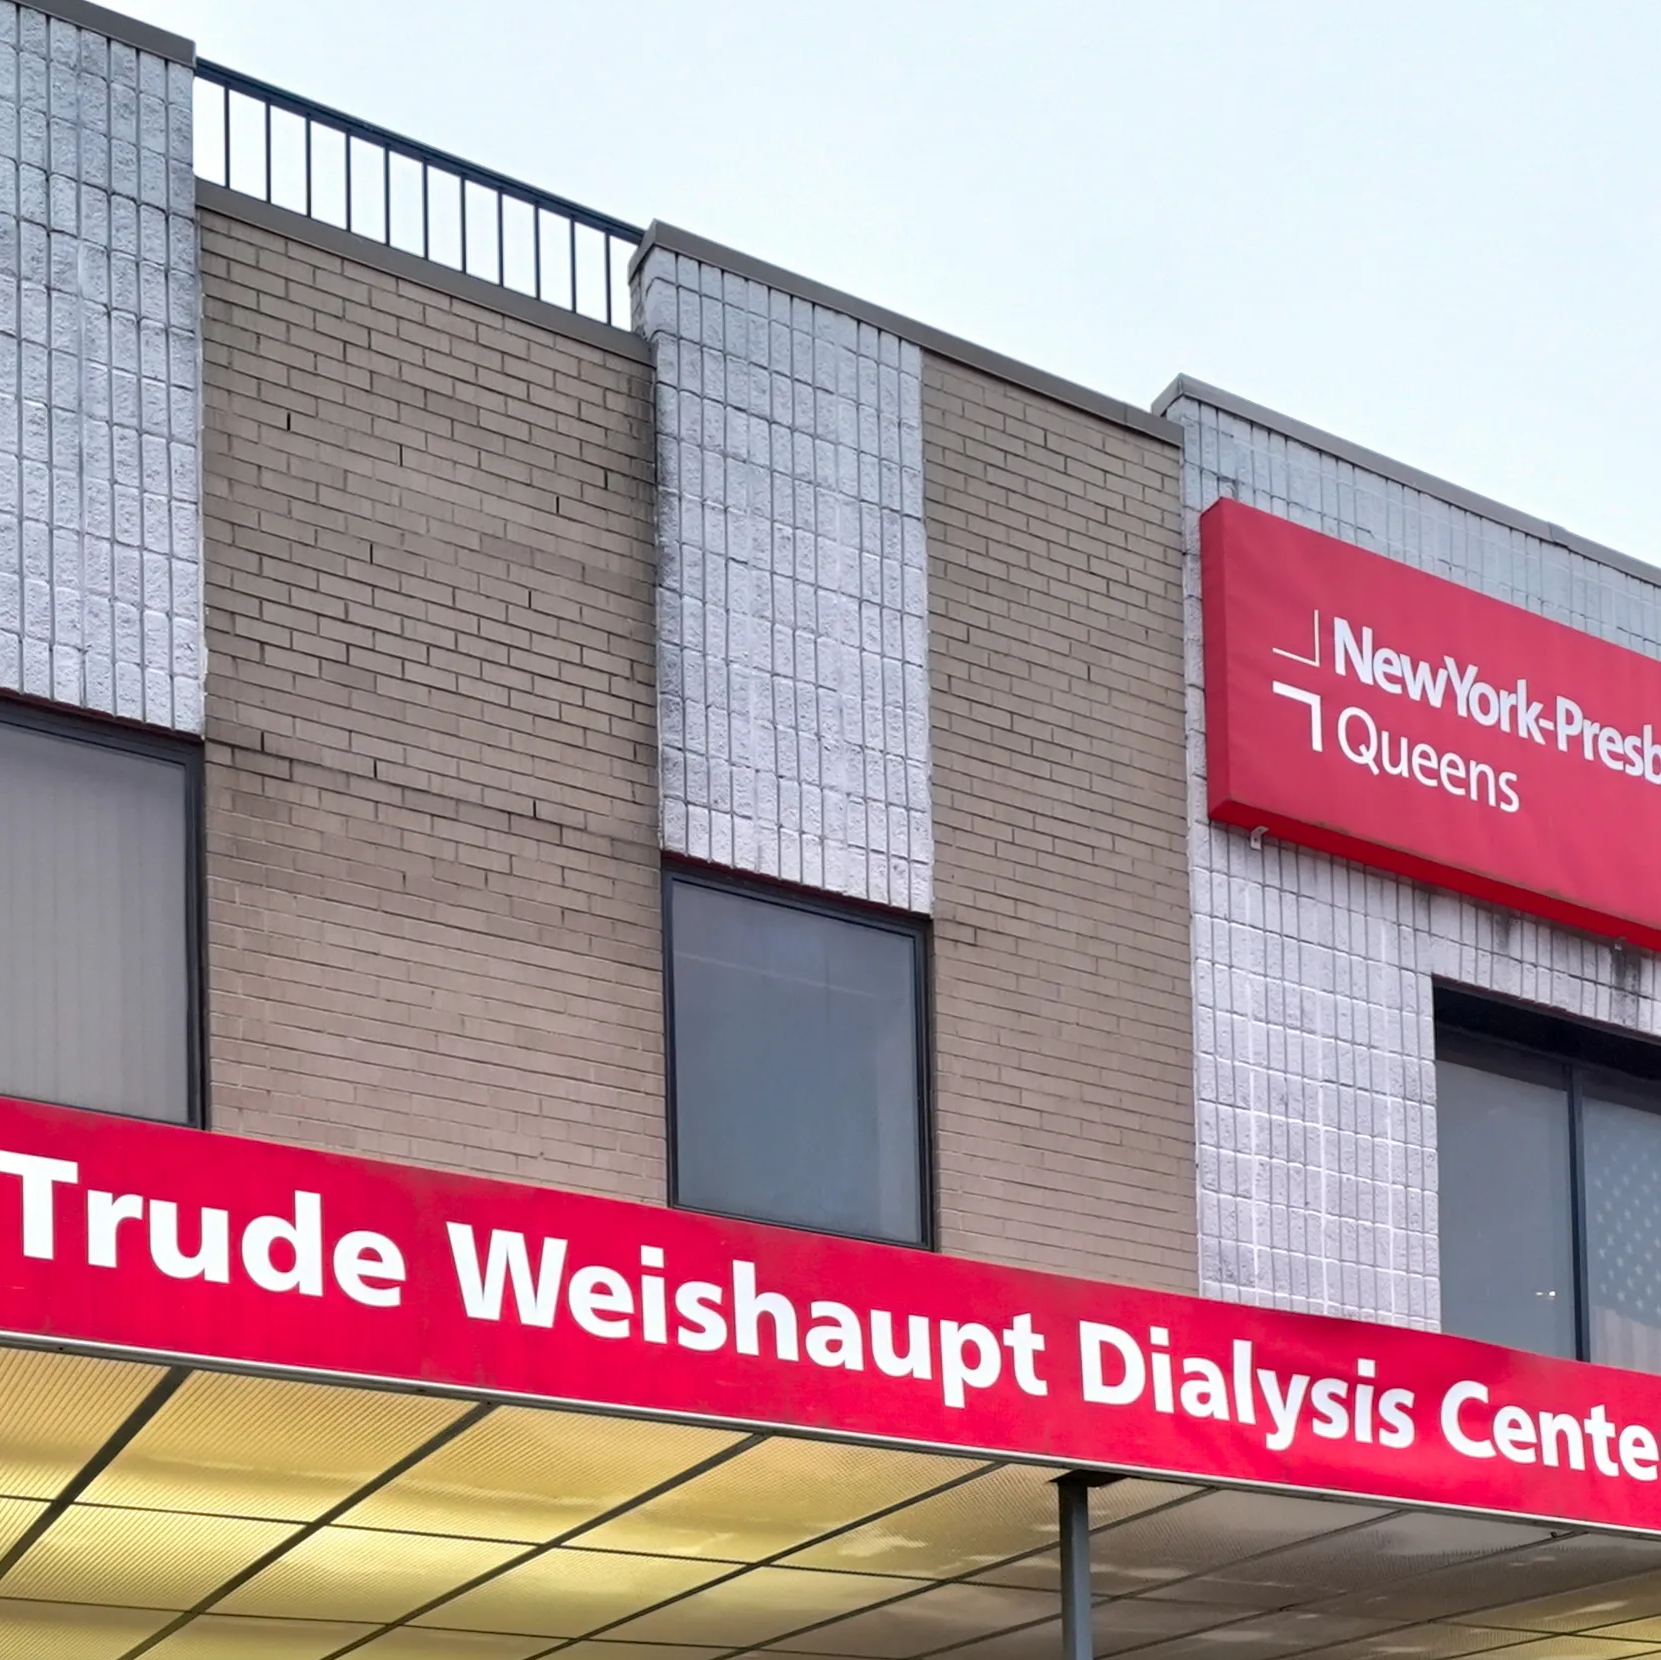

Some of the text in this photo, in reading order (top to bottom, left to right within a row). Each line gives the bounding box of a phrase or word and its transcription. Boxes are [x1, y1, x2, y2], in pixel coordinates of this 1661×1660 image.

[1337, 706, 1520, 813] Queens
[445, 1221, 1048, 1409] Weishaupt
[1078, 1320, 1416, 1451] Dialysis
